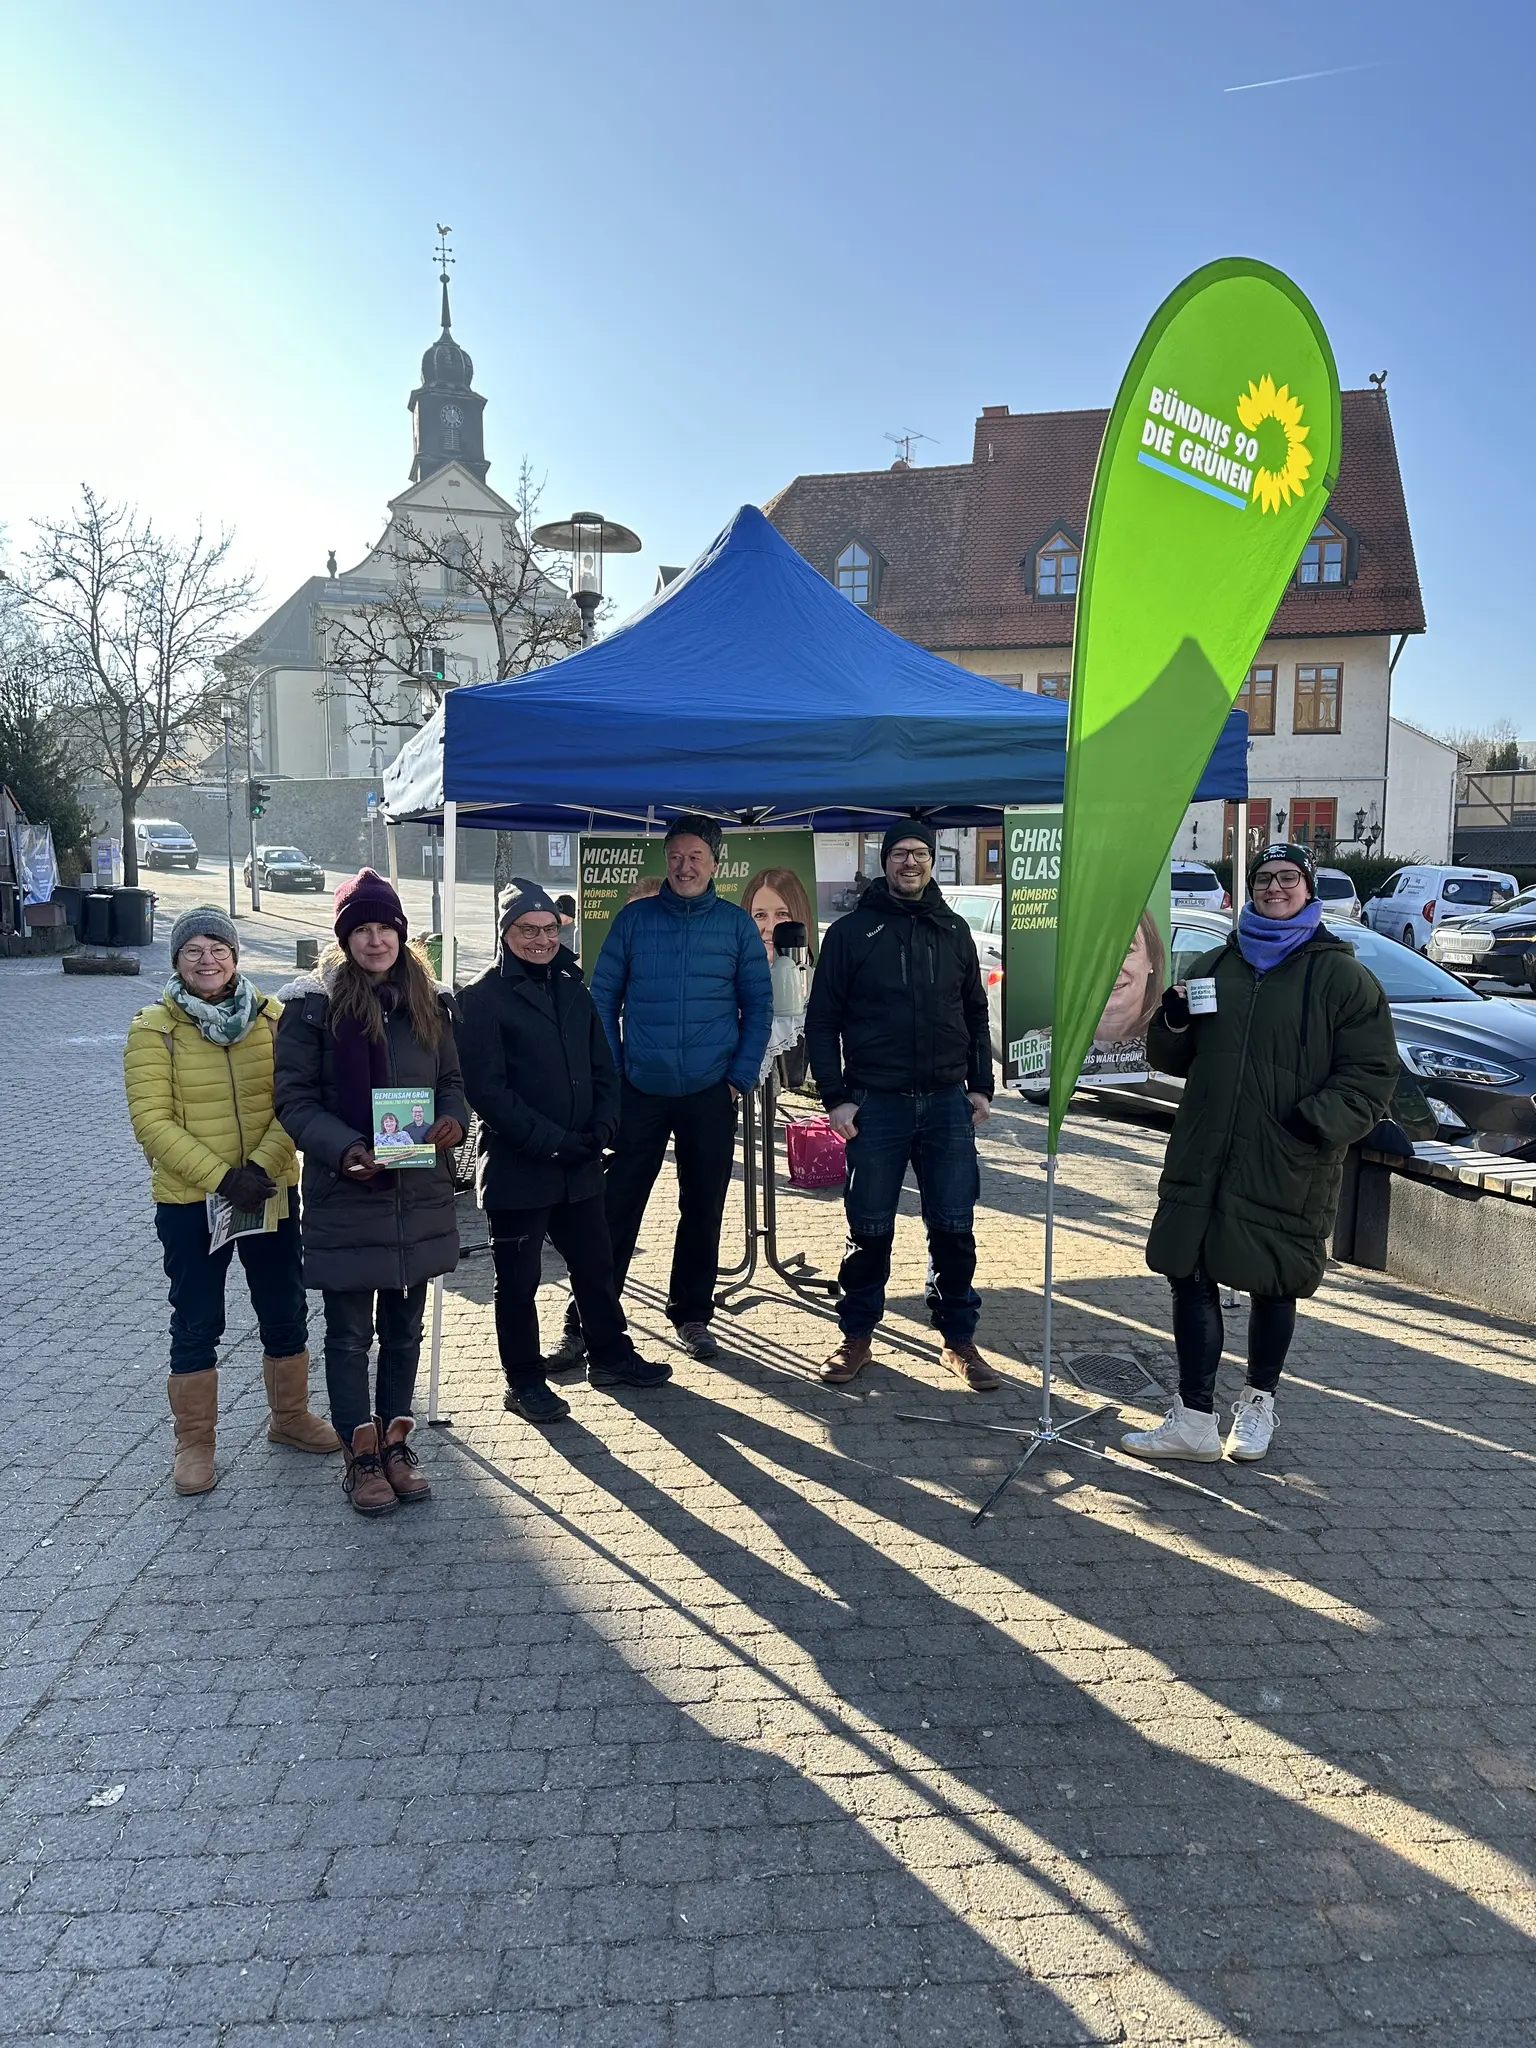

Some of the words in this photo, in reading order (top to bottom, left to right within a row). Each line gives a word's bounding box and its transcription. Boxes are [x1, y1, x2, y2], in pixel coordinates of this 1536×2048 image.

[1148, 386, 1232, 449] BÜNDNIS
[1234, 431, 1259, 462] 90
[1141, 418, 1175, 456] DIE
[1179, 438, 1253, 494] GRÜNEN
[582, 848, 645, 865] MICHAEL
[583, 867, 639, 884] GLASER
[583, 888, 618, 898] MÖMBRIS
[1011, 887, 1058, 901] MÖMBRIS
[583, 900, 602, 909] LEBT
[1011, 902, 1048, 916] KOMMT
[583, 910, 610, 920] VEREIN
[1012, 1039, 1038, 1059] HIER
[1021, 1053, 1044, 1073] WIR
[1095, 1052, 1121, 1064] WÄHLT
[1120, 1051, 1143, 1062] GRÜN!
[411, 1090, 429, 1099] GRÜN
[456, 1137, 475, 1178] HEIMRICH
